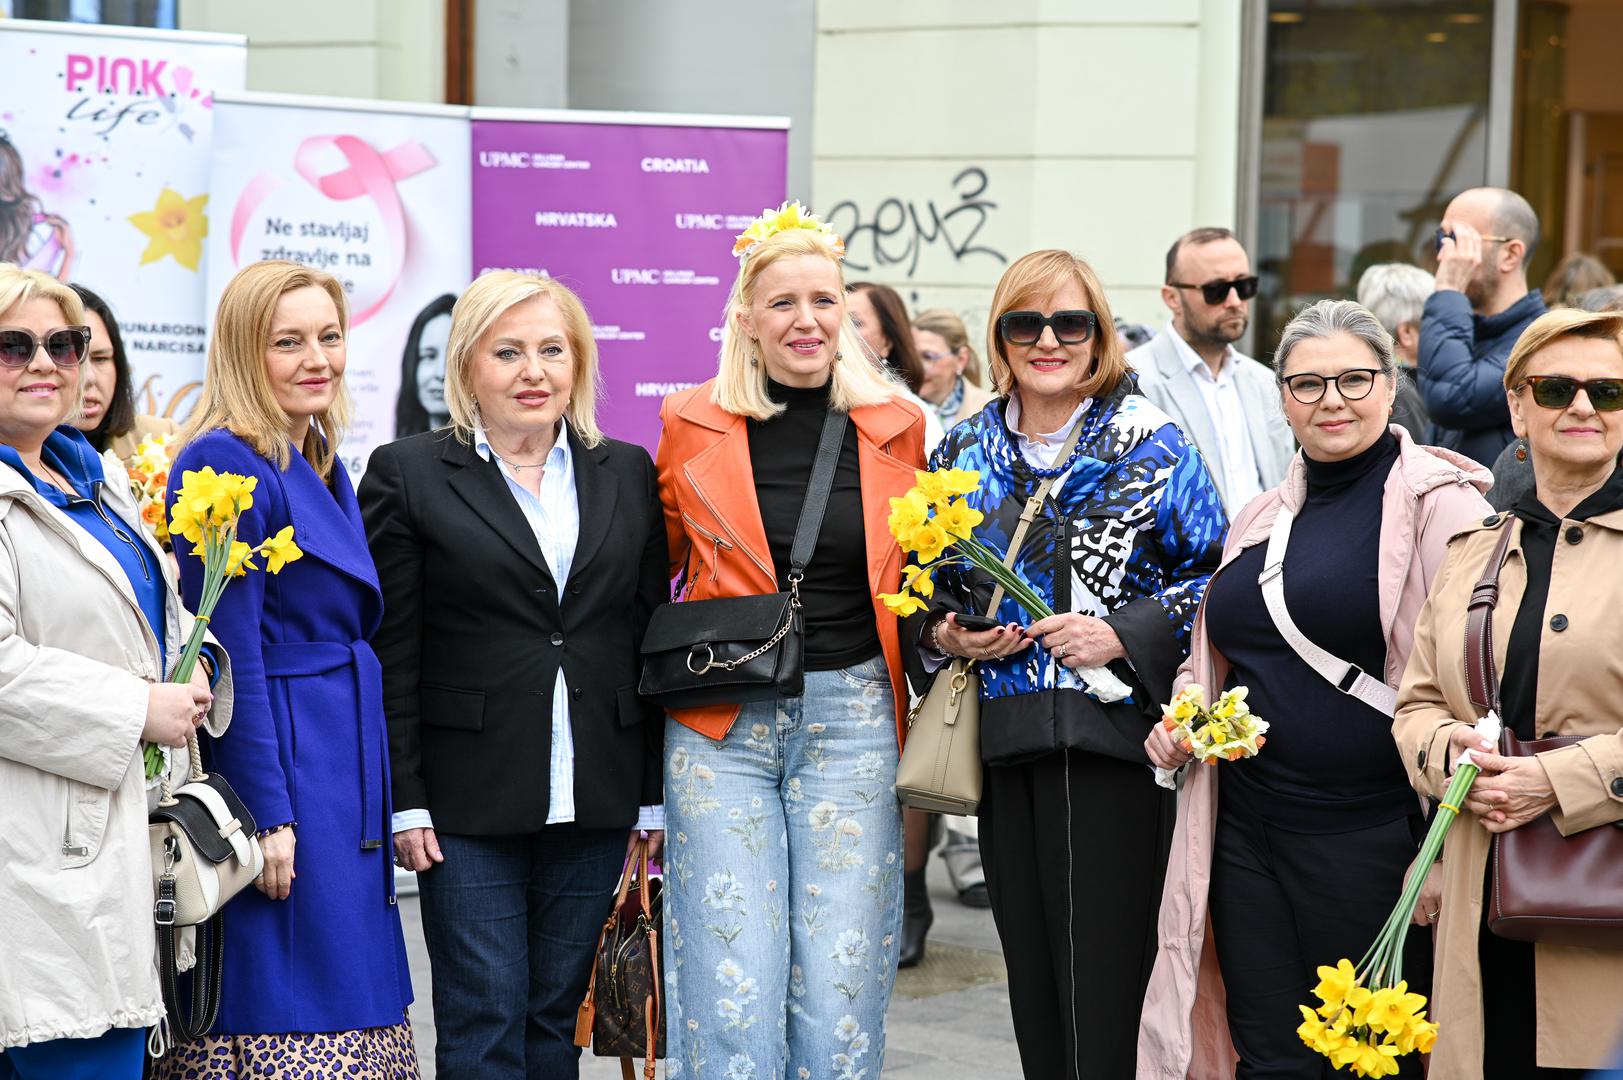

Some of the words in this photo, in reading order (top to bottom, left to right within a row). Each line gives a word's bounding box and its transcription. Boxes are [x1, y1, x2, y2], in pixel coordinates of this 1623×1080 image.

[66, 54, 168, 97] PINK
[66, 97, 160, 136] life
[480, 151, 530, 168] UPMC
[641, 157, 710, 173] CROATIA
[535, 211, 618, 228] HRVATSKA
[675, 213, 724, 230] UPMC
[265, 218, 292, 236] Ne
[300, 220, 369, 243] stavljaj
[262, 246, 339, 268] zdravlje
[346, 252, 371, 266] na
[611, 268, 660, 284] UPMC
[133, 340, 205, 353] NARCISA
